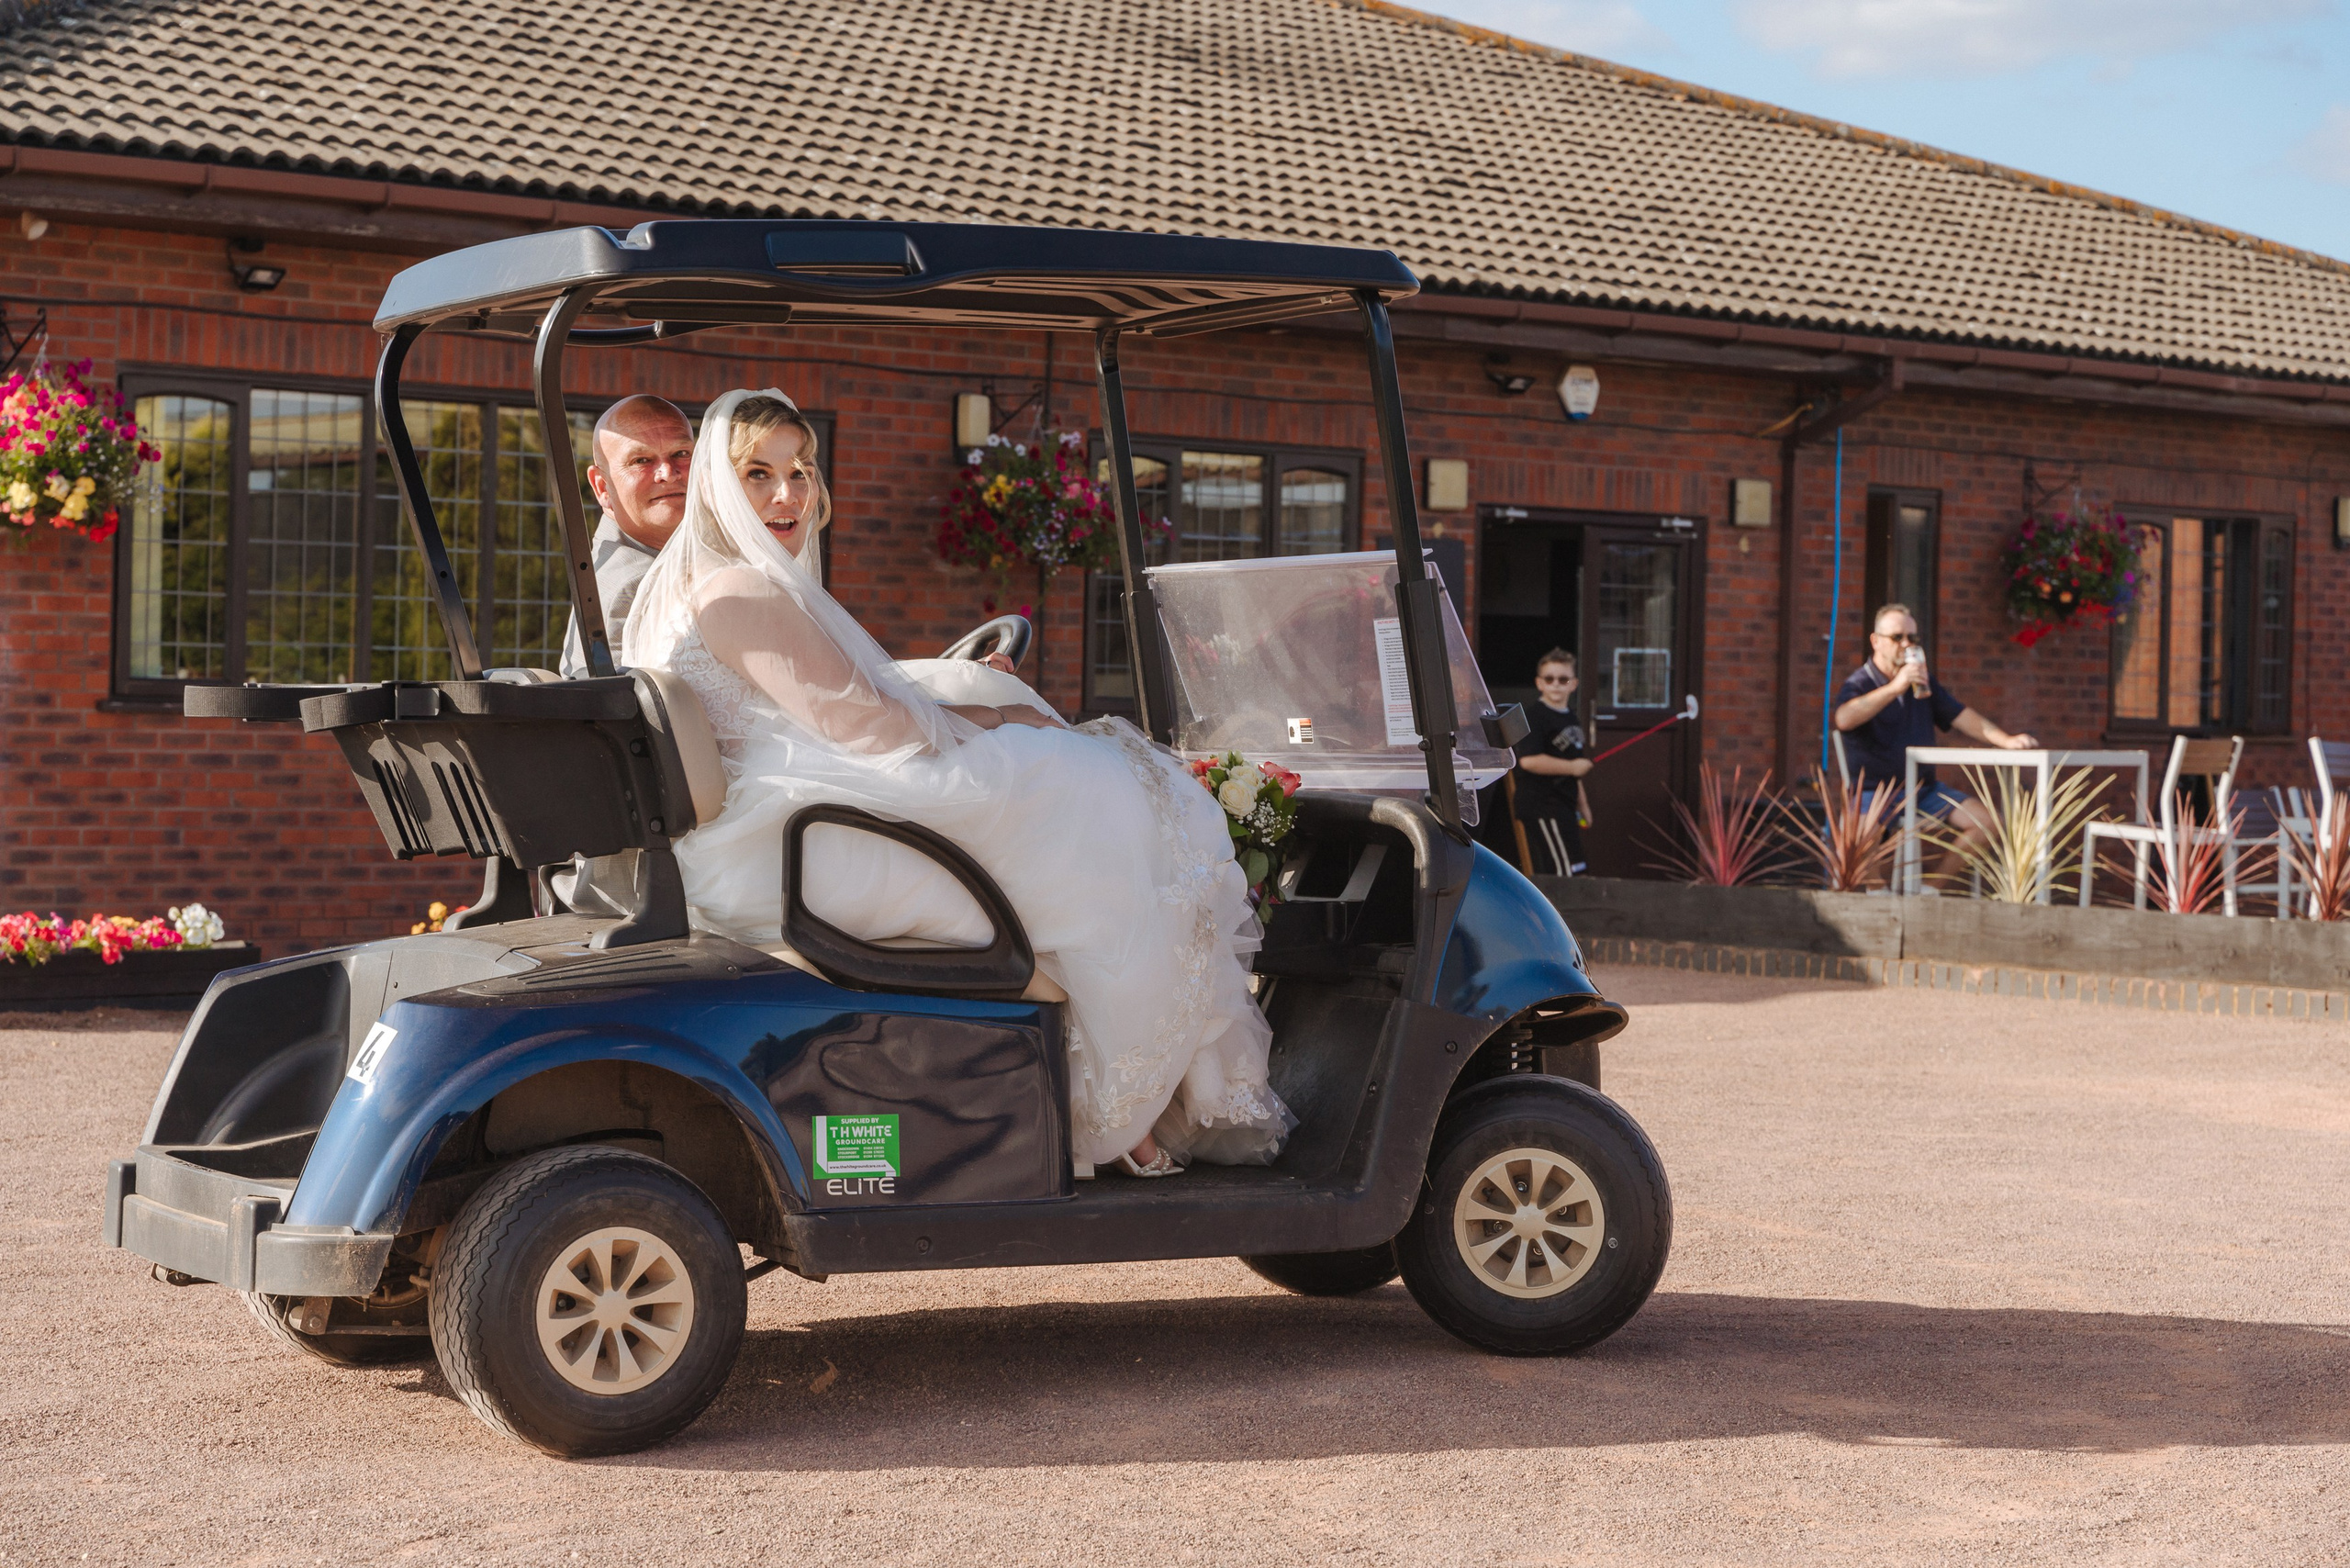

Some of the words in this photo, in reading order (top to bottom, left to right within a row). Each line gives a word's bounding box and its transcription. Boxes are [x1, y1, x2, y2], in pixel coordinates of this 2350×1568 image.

[356, 1030, 385, 1077] 4
[830, 1126, 838, 1137] T
[841, 1126, 849, 1137] H
[852, 1126, 892, 1137] WHITE
[826, 1177, 895, 1195] ELITE
